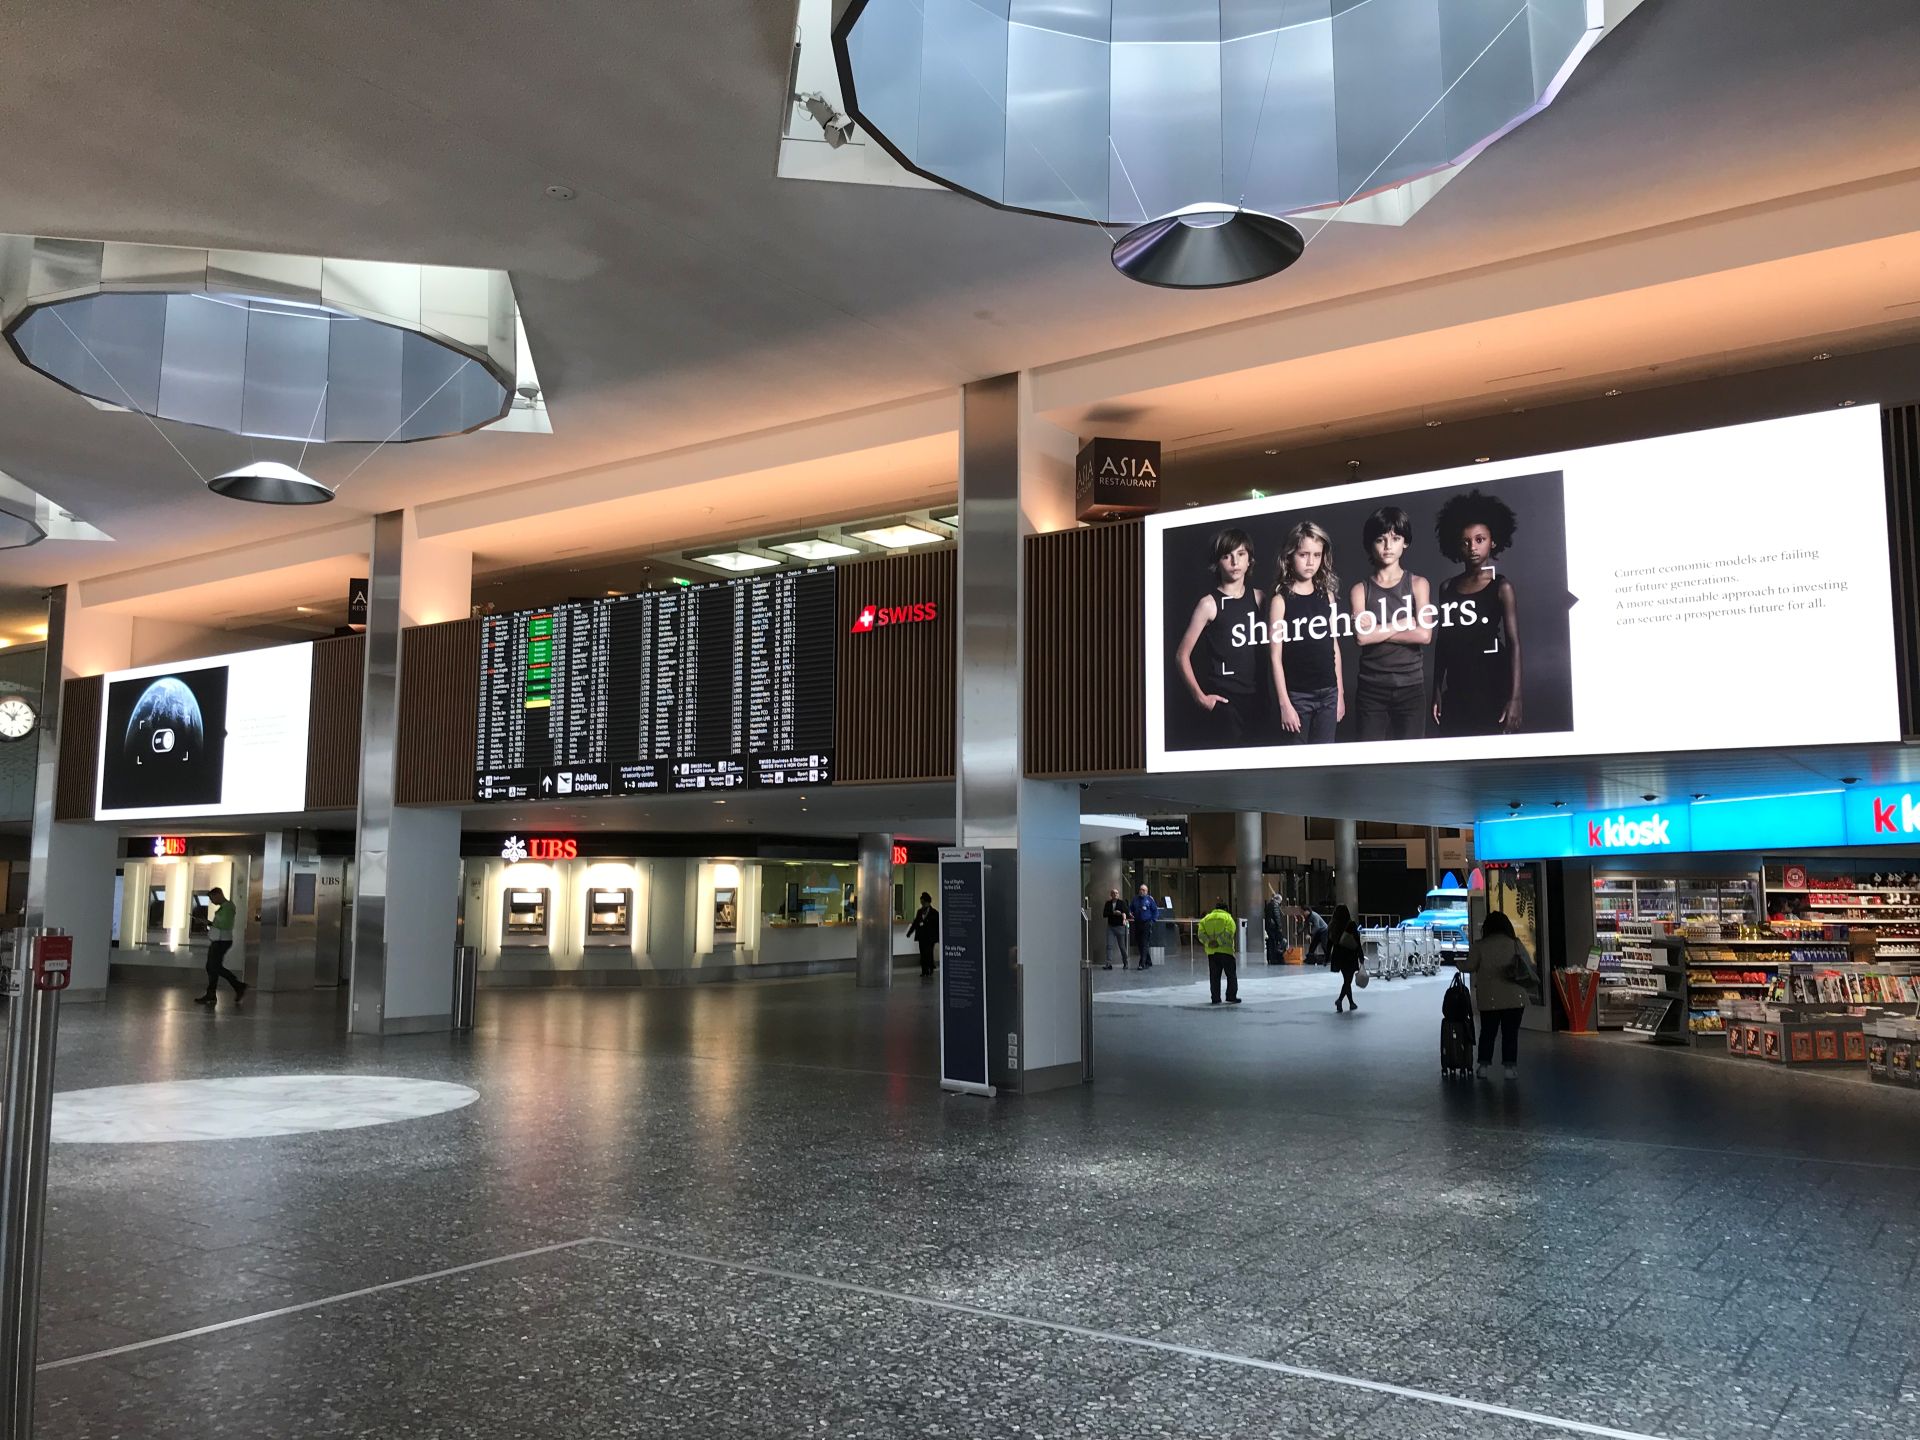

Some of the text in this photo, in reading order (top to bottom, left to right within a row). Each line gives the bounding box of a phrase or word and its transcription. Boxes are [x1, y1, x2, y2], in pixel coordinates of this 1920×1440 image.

[1100, 457, 1157, 477] ASIA
[1100, 477, 1156, 488] RESTAURANT
[1614, 548, 1820, 578] Current economic models are failing
[1615, 574, 1740, 594] our future generations.
[1616, 580, 1848, 609] A more sustainable approach to investing
[878, 602, 937, 626] SWISS
[1231, 594, 1489, 647] shareholders.
[1616, 598, 1826, 625] can secure a prosperous future for all.
[575, 773, 597, 782] Abflug
[575, 782, 609, 792] Departure
[1873, 796, 1898, 833] k
[1588, 813, 1672, 848] k kiosk
[165, 838, 186, 854] UBS
[530, 839, 577, 860] UBS
[893, 846, 907, 864] BS
[321, 877, 340, 885] UBS
